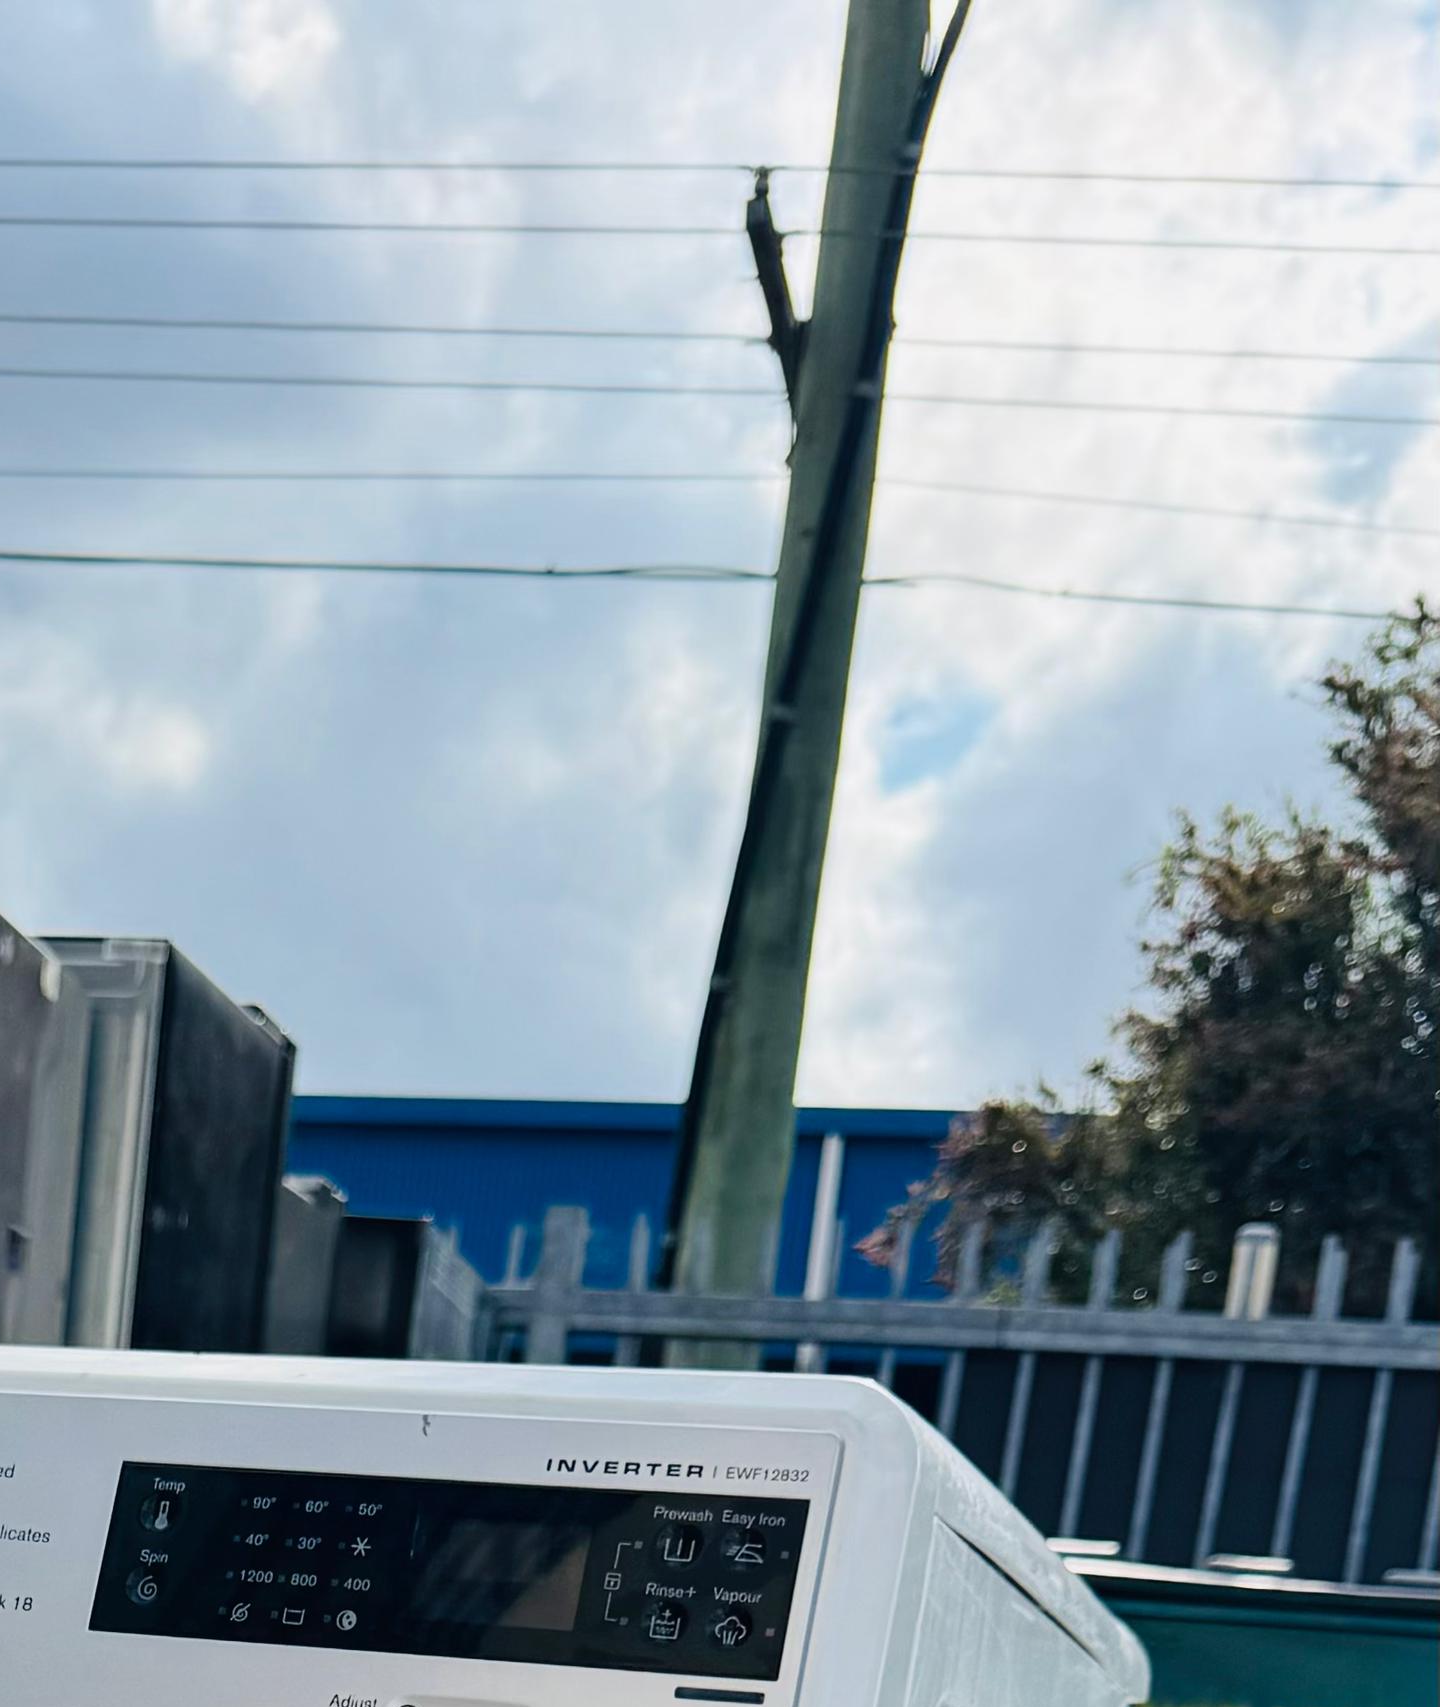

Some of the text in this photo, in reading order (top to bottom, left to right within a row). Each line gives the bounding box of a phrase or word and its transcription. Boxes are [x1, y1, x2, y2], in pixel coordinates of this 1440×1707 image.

[546, 1458, 809, 1483] INVERTER EWF12832
[153, 1477, 186, 1494] Temp
[653, 1506, 786, 1528] Prewash Easy Iron
[139, 1549, 168, 1565] Spin
[240, 1569, 371, 1592] 1200 800 400
[12, 1596, 33, 1611] 18
[645, 1582, 762, 1605] Rinse+ Vapour
